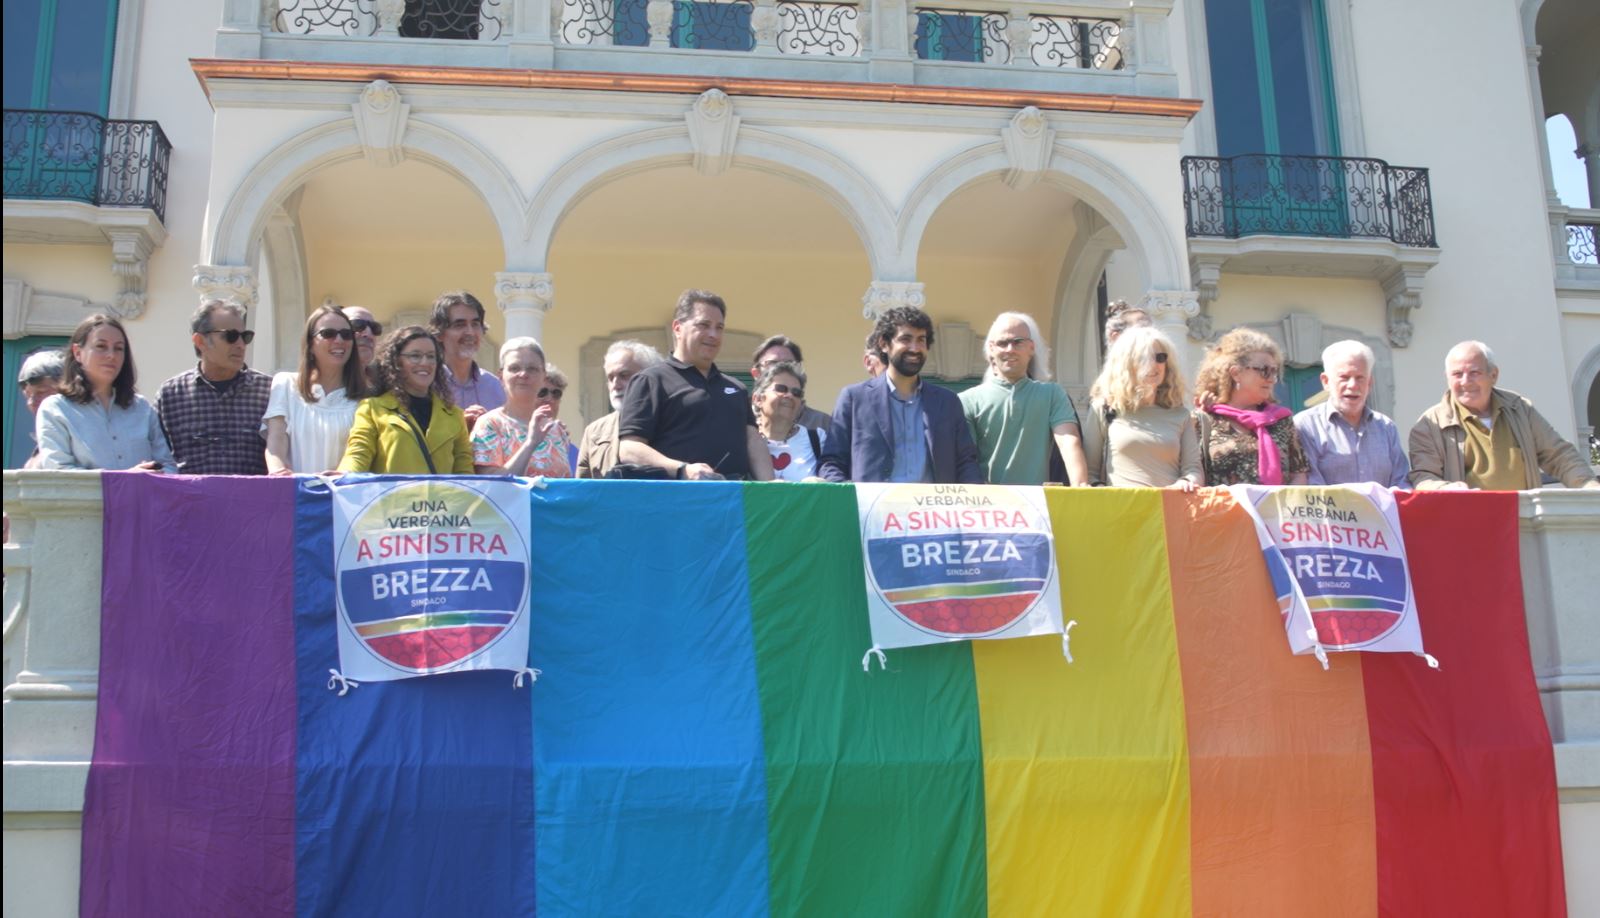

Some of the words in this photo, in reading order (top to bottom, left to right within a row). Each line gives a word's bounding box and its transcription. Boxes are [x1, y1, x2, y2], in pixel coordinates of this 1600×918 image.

[934, 485, 968, 494] UNA
[412, 500, 448, 513] UNA
[914, 496, 992, 506] VERBANIA
[1306, 494, 1336, 508] UNA
[388, 515, 471, 529] VERBANIA
[883, 512, 903, 532] A
[909, 509, 1029, 529] SINISTRA
[1289, 506, 1358, 522] VERBANIA
[1281, 522, 1389, 550] SINISTRA
[356, 538, 374, 562] A
[379, 532, 508, 558] SINISTRA
[901, 539, 1023, 568] BREZZA
[1284, 554, 1383, 583] REZZA
[371, 567, 493, 600] BREZZA
